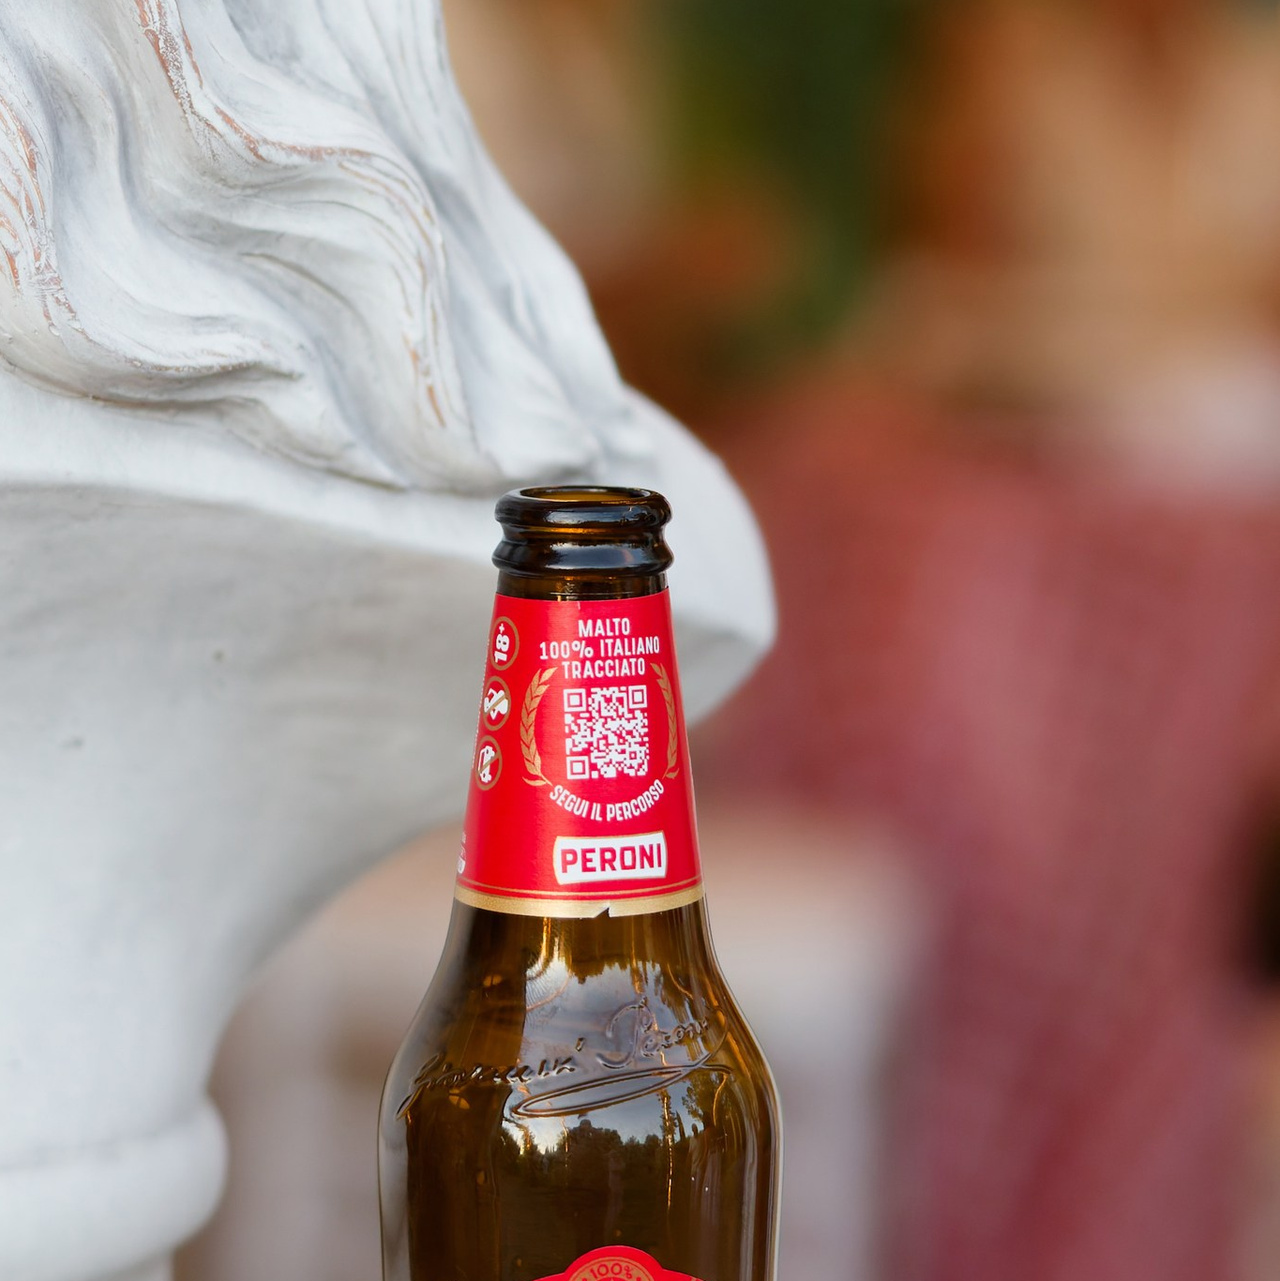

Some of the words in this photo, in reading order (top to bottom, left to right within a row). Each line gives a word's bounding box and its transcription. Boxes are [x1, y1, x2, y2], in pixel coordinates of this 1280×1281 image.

[577, 618, 630, 637] MALTO
[494, 622, 510, 663] 18+
[539, 640, 594, 660] 100%
[600, 635, 660, 657] ITALIANO
[561, 658, 646, 679] TRACCIATO
[549, 784, 589, 818] SEGUI
[590, 802, 603, 821] IL
[606, 779, 665, 822] PERCORSO
[560, 842, 662, 874] PERONI
[589, 1263, 633, 1280] 100%
